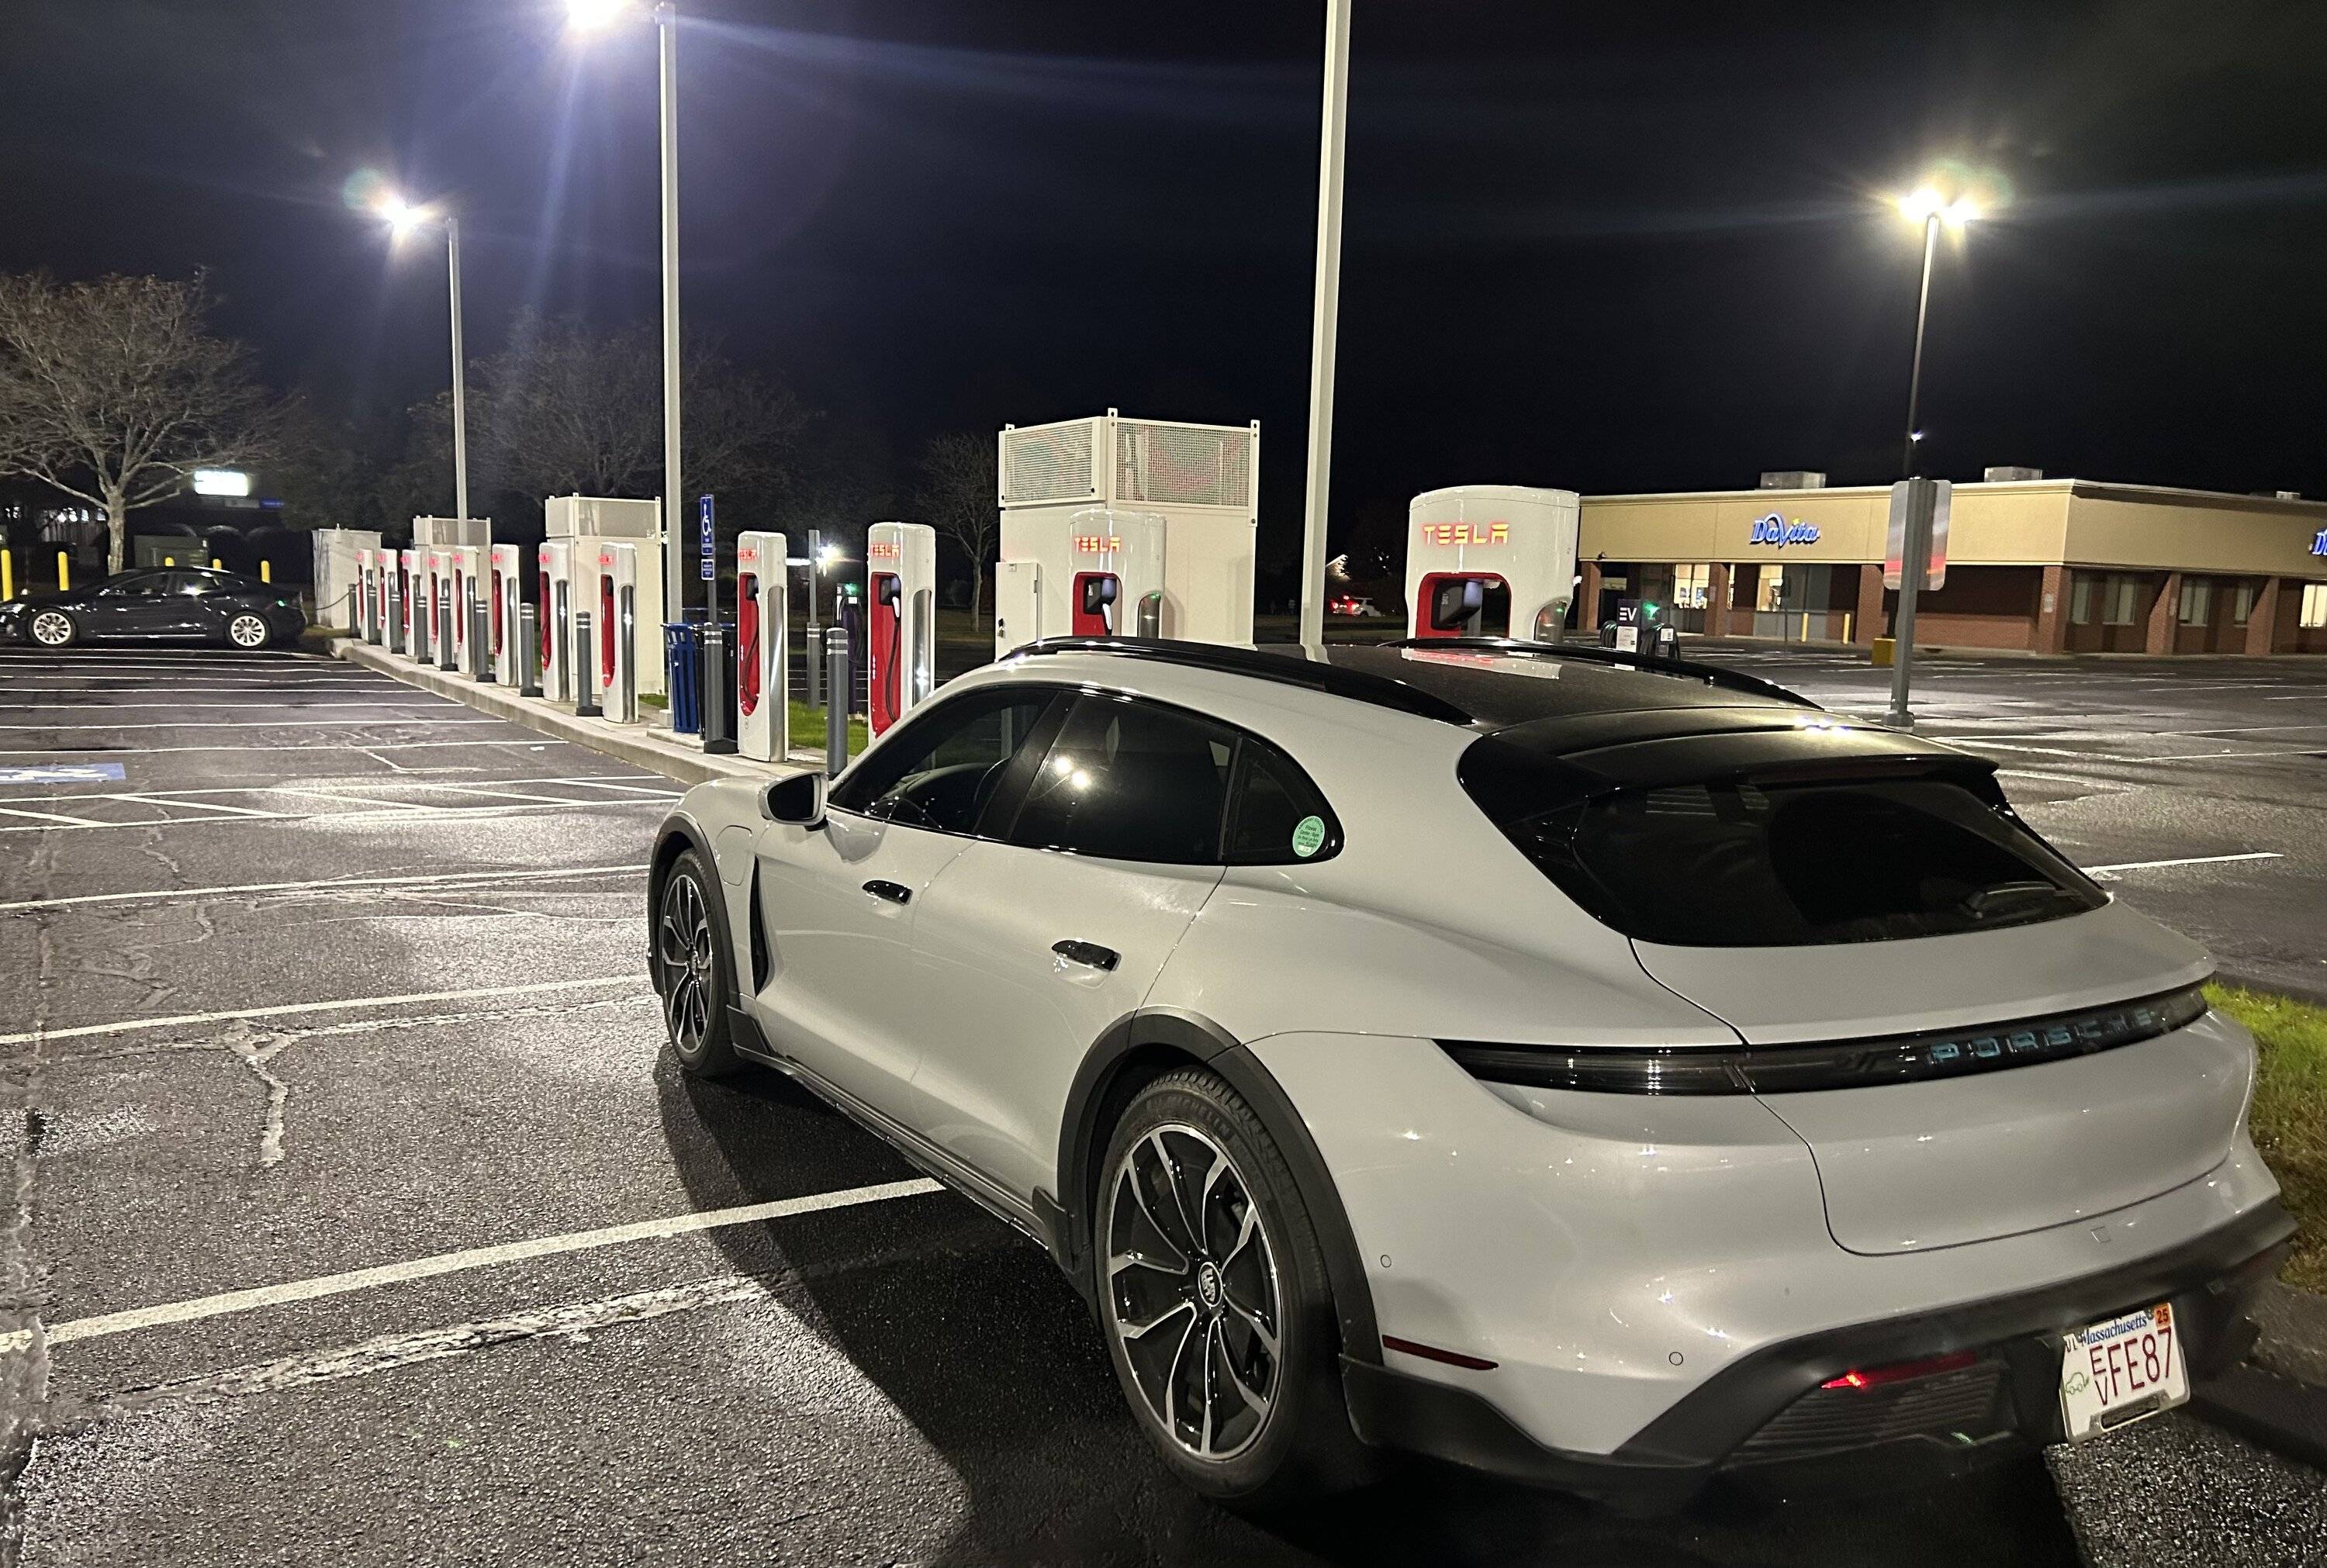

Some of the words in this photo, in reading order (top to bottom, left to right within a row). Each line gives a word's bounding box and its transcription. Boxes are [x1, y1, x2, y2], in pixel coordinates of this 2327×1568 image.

[1423, 523, 1509, 544] TESLA
[1750, 513, 1820, 547] DaVita
[1074, 537, 1120, 552] TESLA
[1619, 607, 1637, 620] EV
[1929, 1009, 2155, 1063] PORSCHE
[2156, 1308, 2169, 1325] 25
